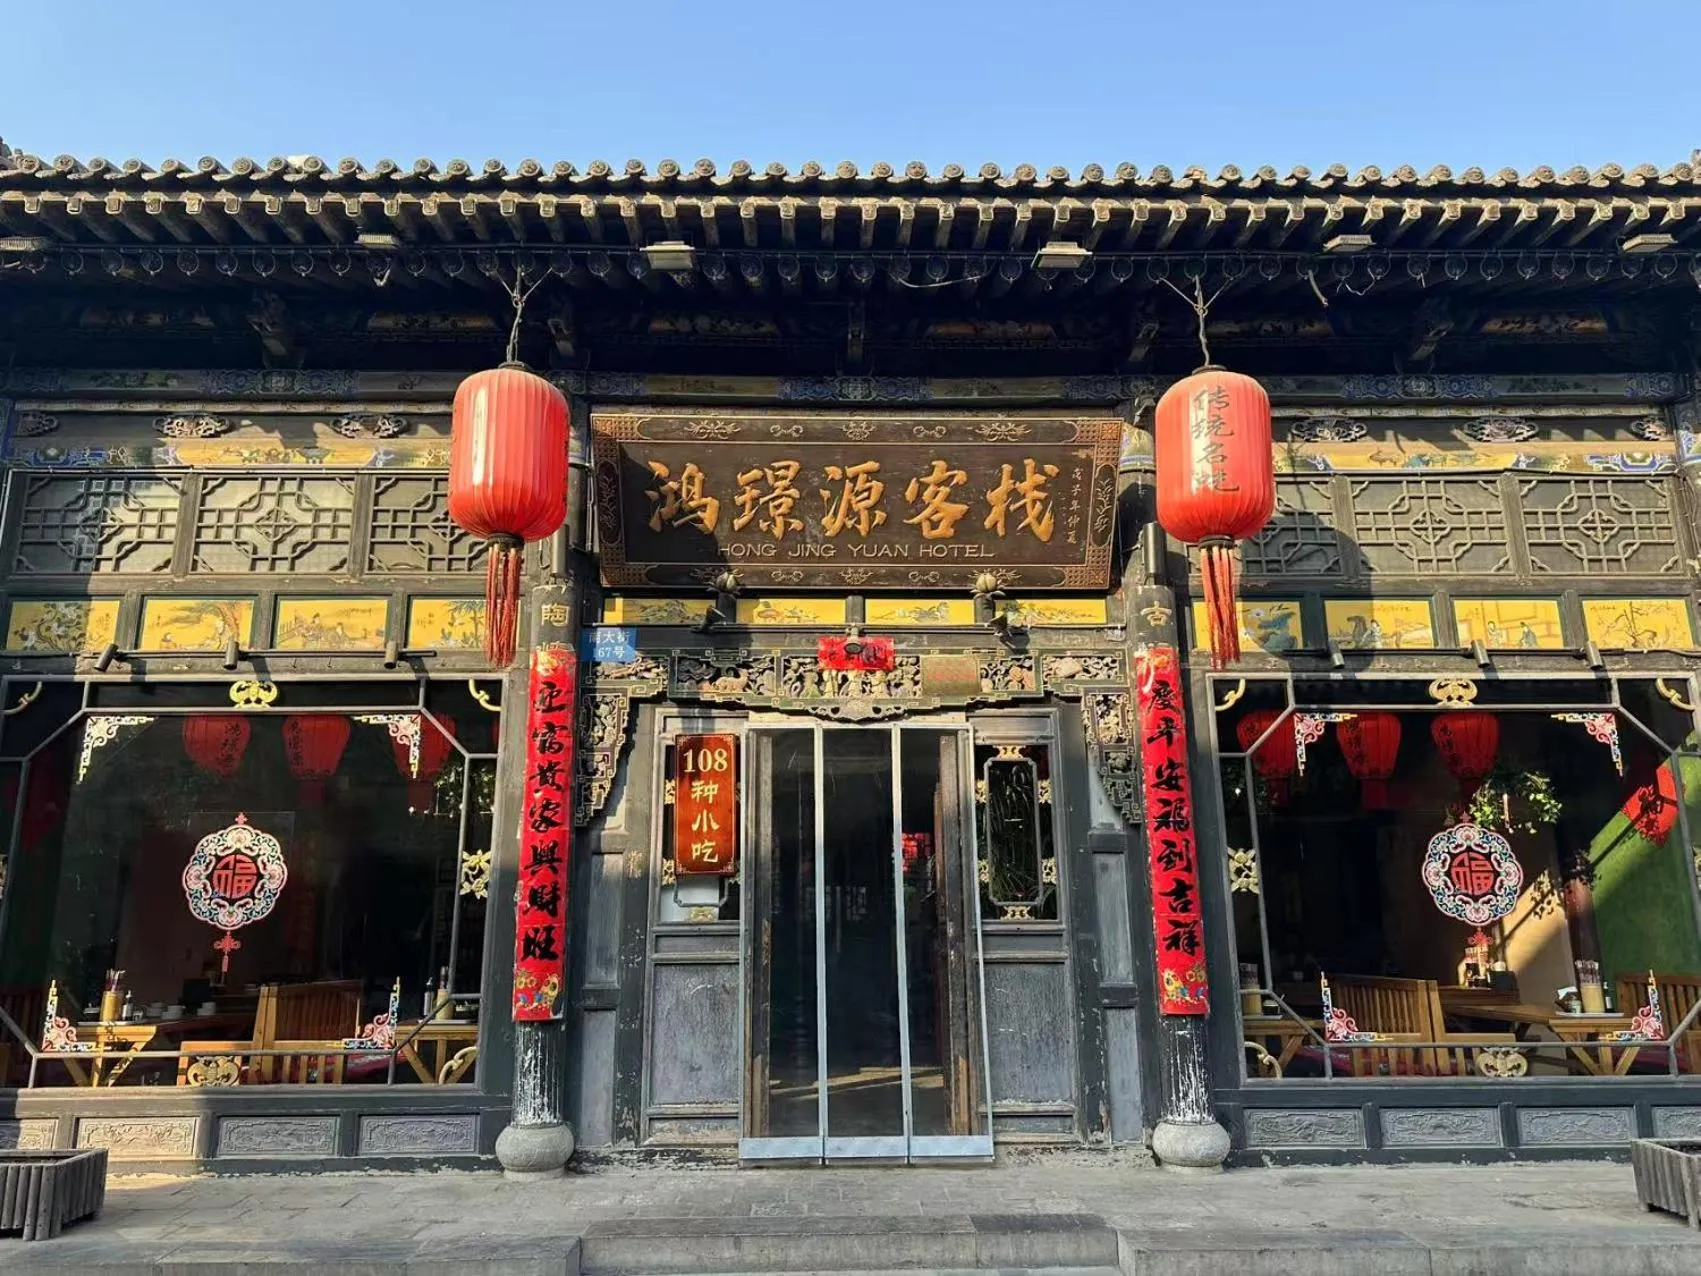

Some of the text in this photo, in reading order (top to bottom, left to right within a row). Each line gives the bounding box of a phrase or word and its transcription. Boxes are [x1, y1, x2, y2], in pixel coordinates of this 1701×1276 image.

[644, 457, 1061, 542] 鸿璟源客栈
[719, 543, 997, 558] HONG JING YUAN HOTEL
[588, 631, 631, 644] 南大街
[598, 646, 626, 659] 67号
[683, 748, 728, 773] 108
[691, 780, 720, 863] 种小吃
